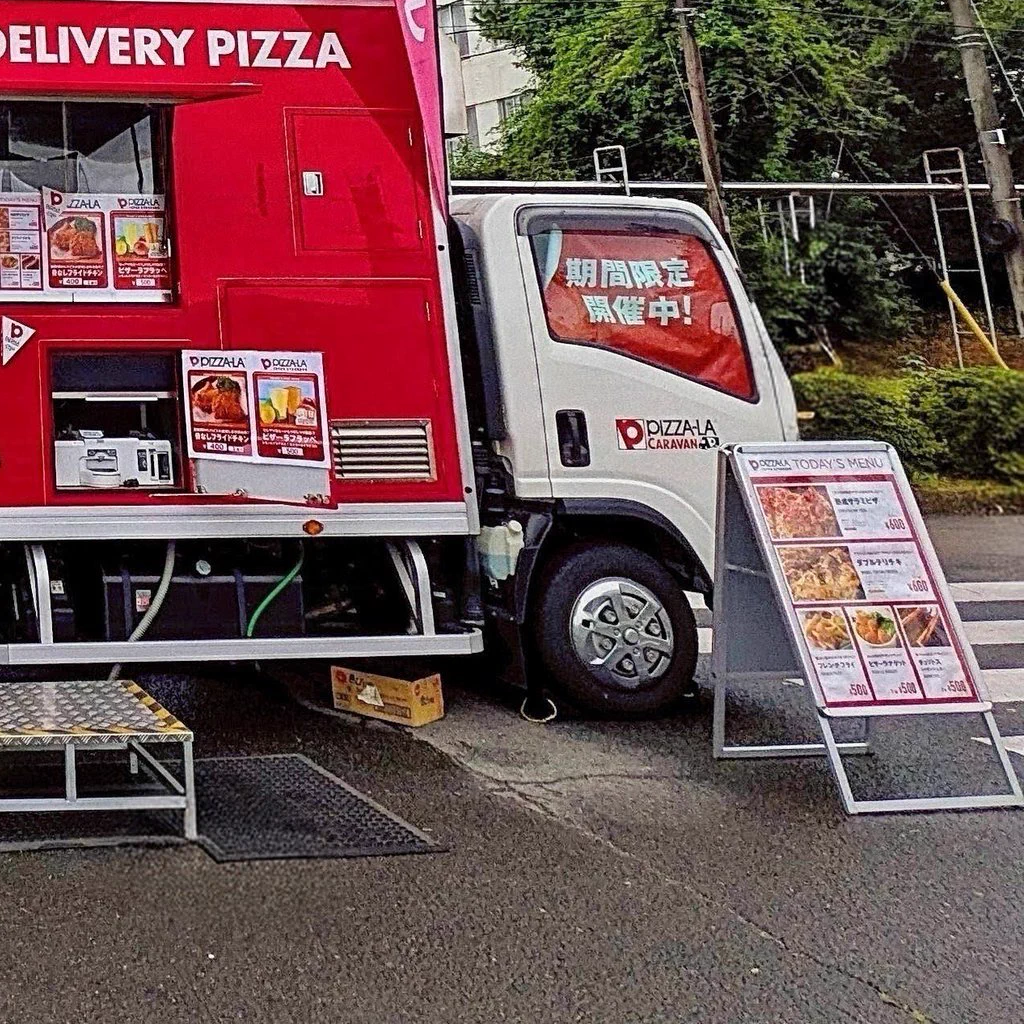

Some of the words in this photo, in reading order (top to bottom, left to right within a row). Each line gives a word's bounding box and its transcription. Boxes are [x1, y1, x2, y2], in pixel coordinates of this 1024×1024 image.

[207, 30, 352, 69] PIZZA
[67, 199, 102, 209] ZZA-LA
[565, 257, 695, 289] 期間限定
[581, 295, 693, 326] 開催中!
[648, 437, 698, 450] CARAVAN
[792, 458, 845, 470] TODAY'S
[848, 457, 884, 469] MENU
